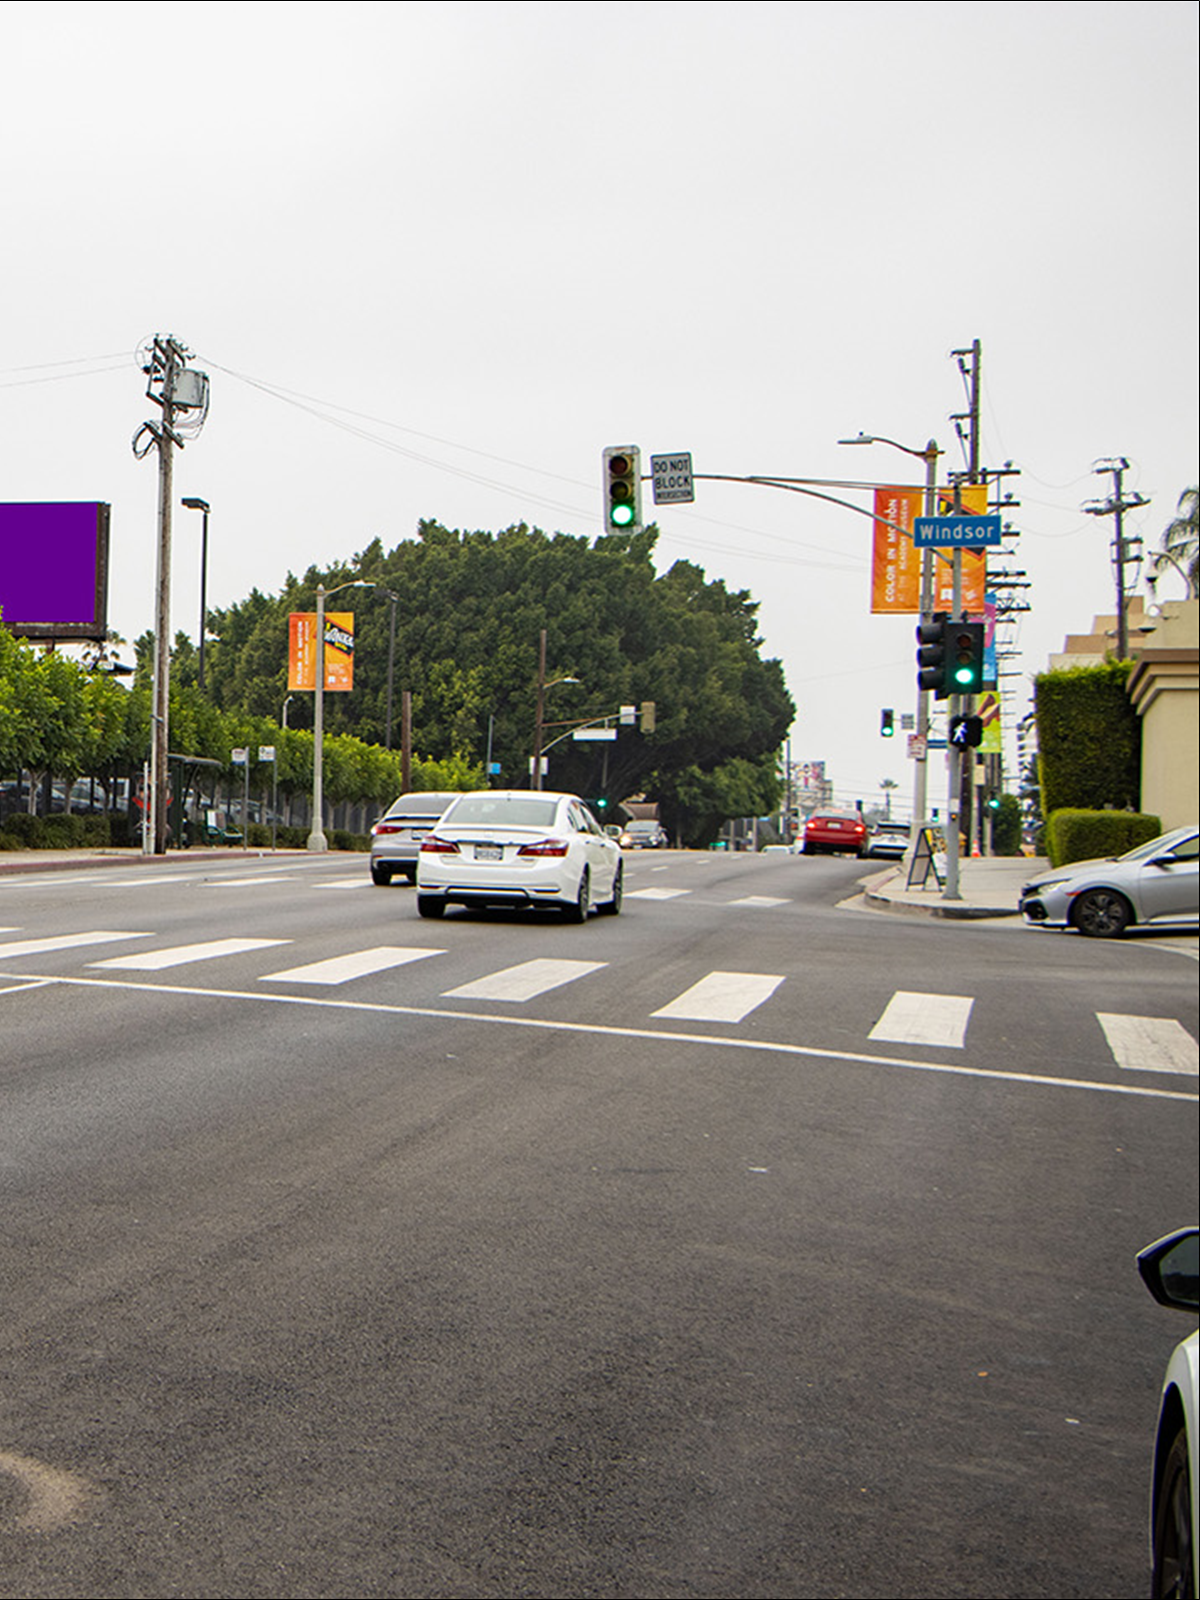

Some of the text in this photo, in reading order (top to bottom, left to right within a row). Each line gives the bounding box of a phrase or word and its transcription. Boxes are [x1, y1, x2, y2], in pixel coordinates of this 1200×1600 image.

[654, 459, 689, 473] DO NOT
[655, 475, 690, 489] BLOCK
[919, 524, 995, 540] Windsor
[887, 549, 896, 560] IN
[886, 566, 896, 602] COLOR
